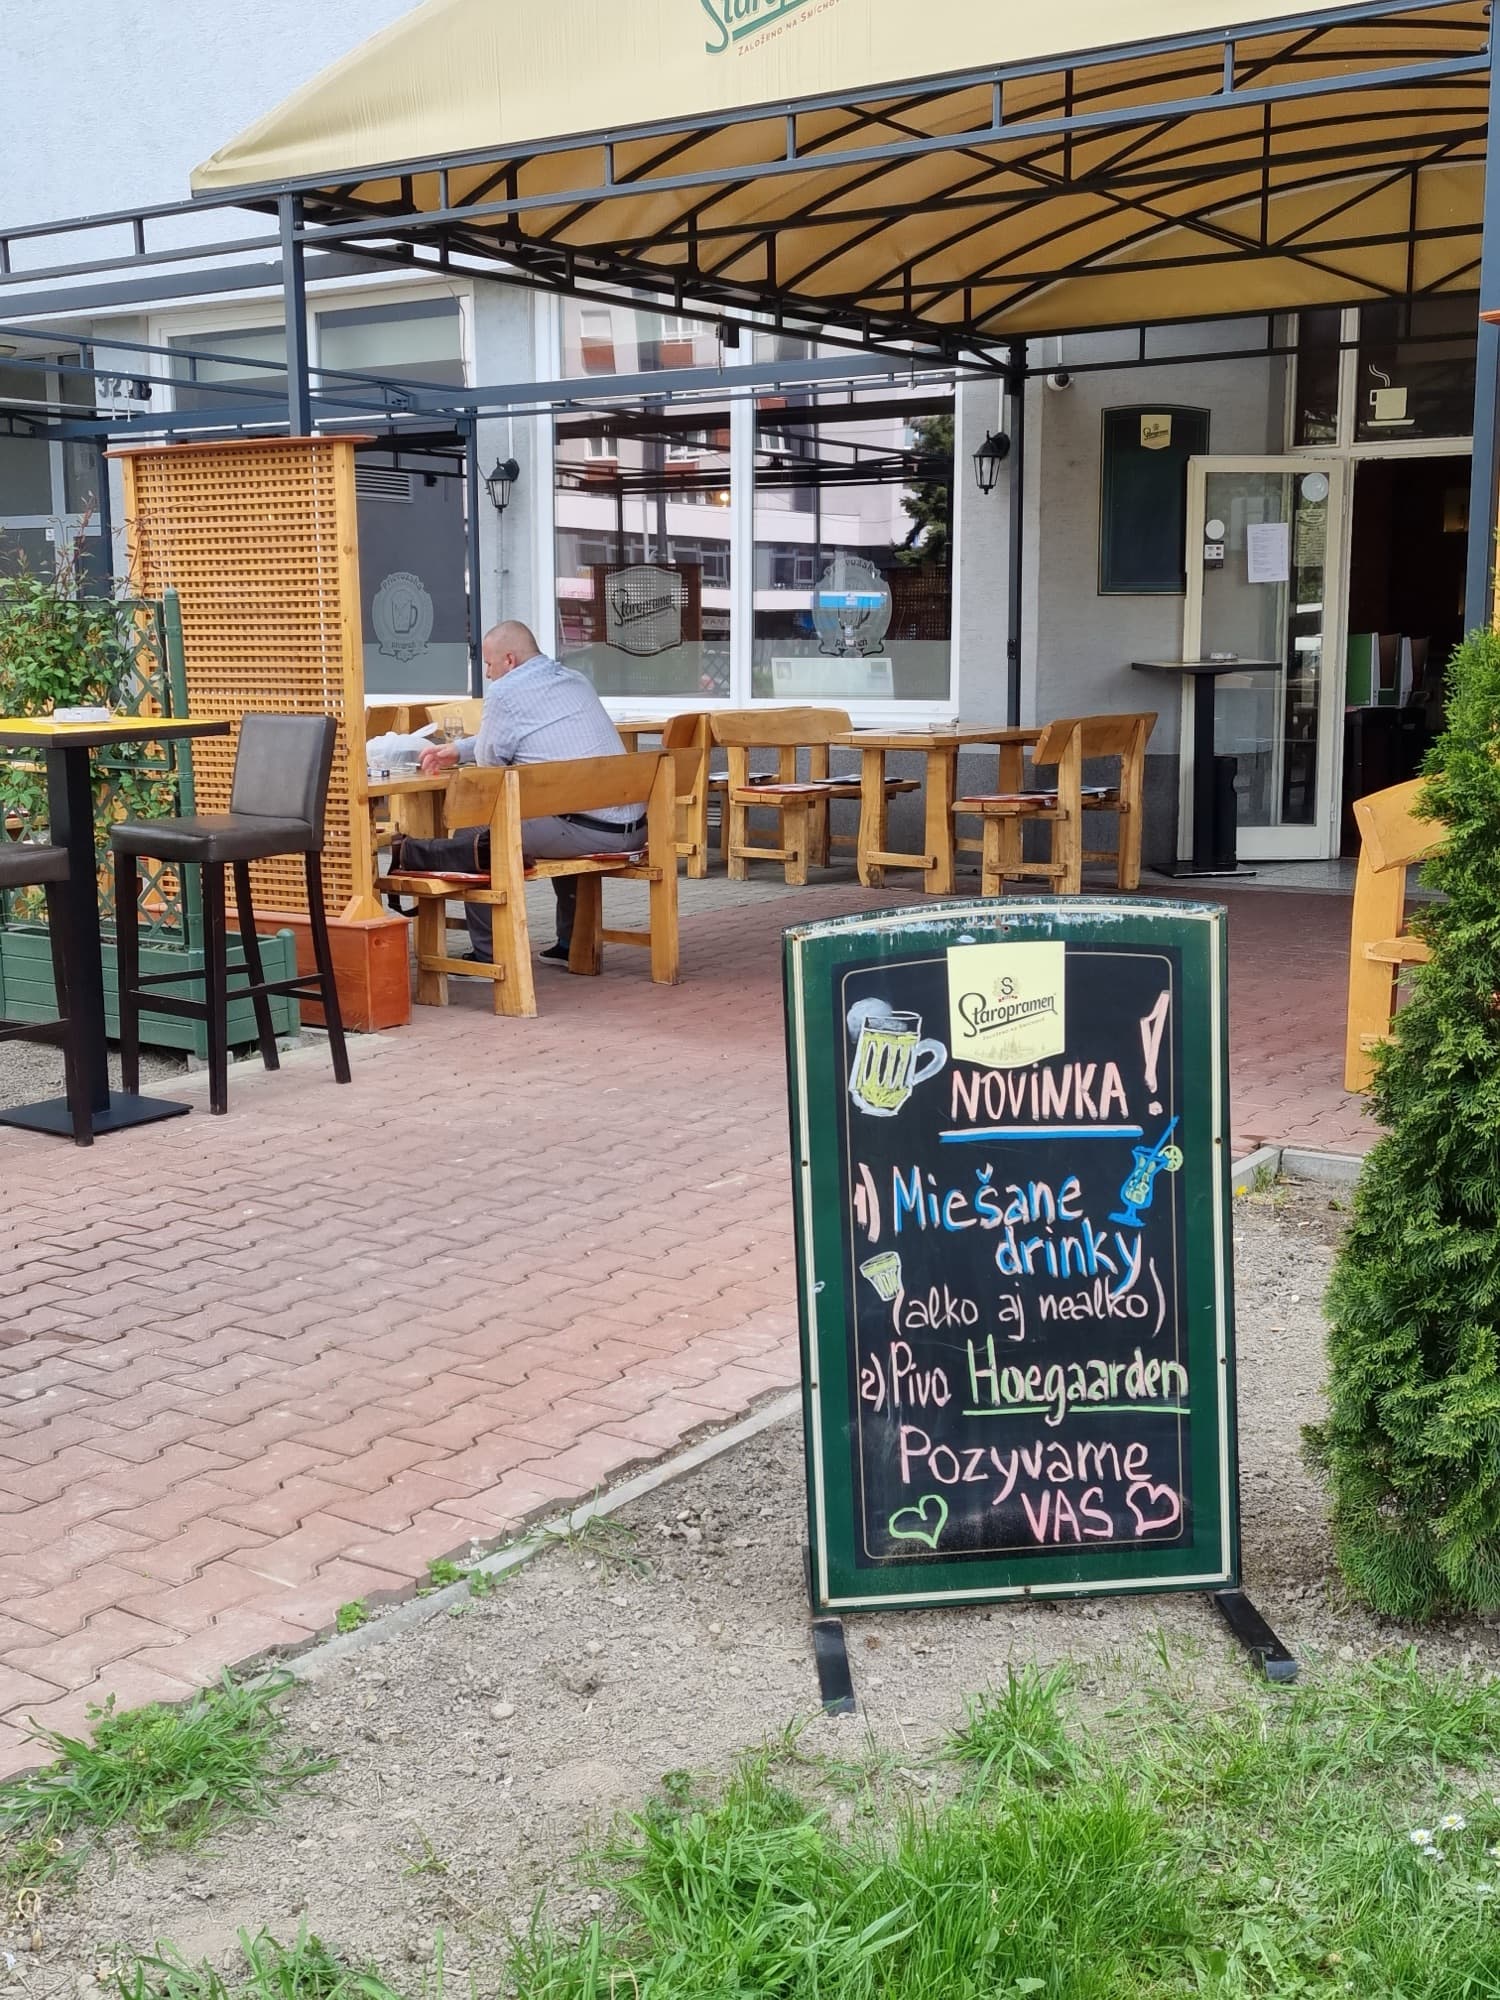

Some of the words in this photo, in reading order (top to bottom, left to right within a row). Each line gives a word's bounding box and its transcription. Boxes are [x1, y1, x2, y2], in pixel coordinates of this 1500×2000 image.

[785, 20, 799, 30] NA
[958, 992, 1058, 1038] Staropramen
[995, 1216, 1143, 1297] drinky
[891, 1283, 979, 1336] (alko
[998, 1282, 1027, 1341] aj
[1039, 1257, 1166, 1339] nealko)
[889, 1340, 951, 1410] Pivo
[966, 1333, 1190, 1428] Hoegaarden
[899, 1424, 1153, 1507] Pozyvame
